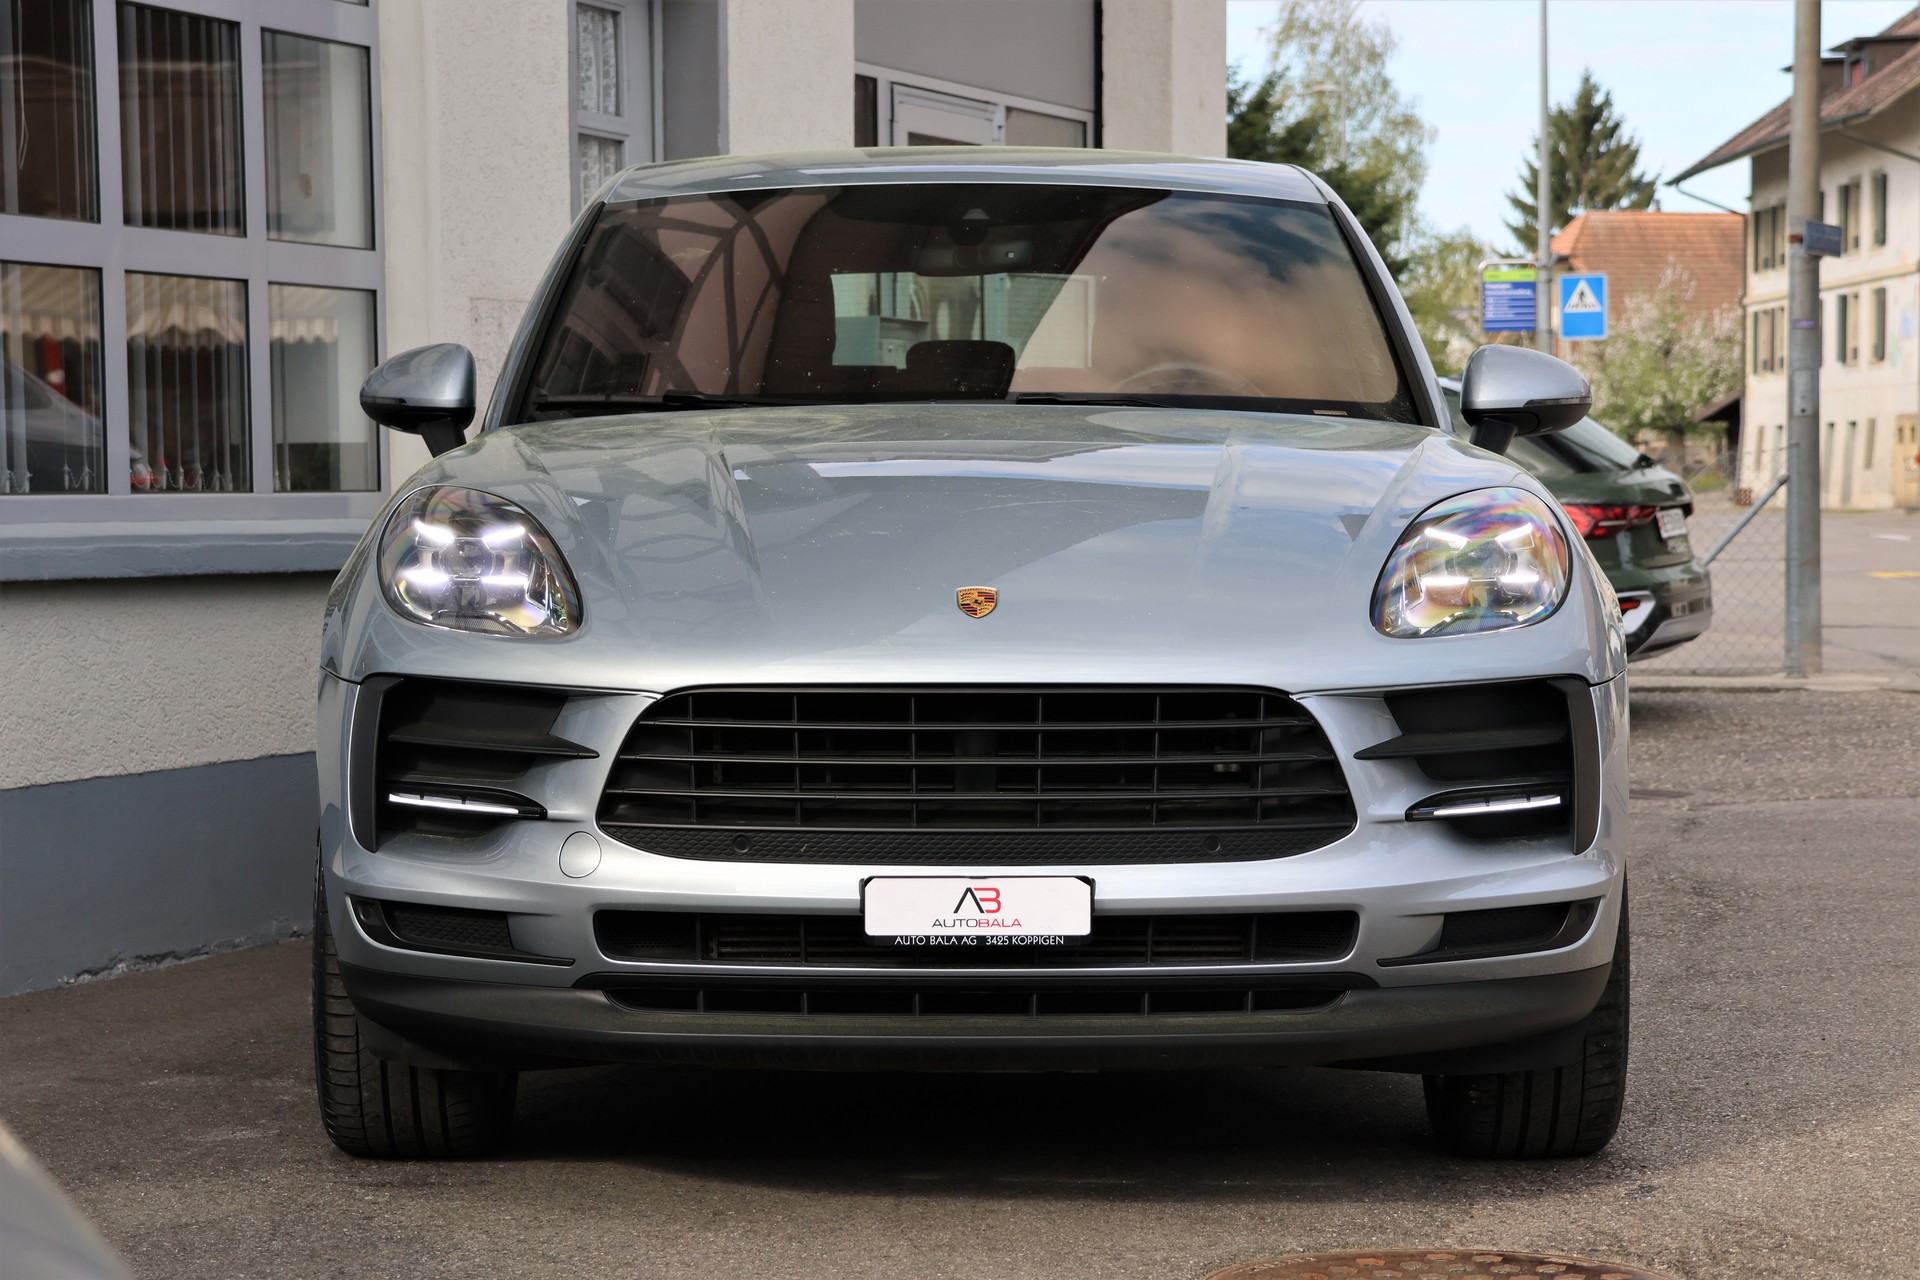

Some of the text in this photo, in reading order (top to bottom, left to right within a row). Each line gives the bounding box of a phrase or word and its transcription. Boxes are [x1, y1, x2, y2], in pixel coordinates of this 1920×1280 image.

[953, 887, 1001, 914] AB
[932, 918, 1022, 928] AUTOBALA
[894, 936, 1064, 945] AUTO BALA AG 3425 KOPPIGEN
